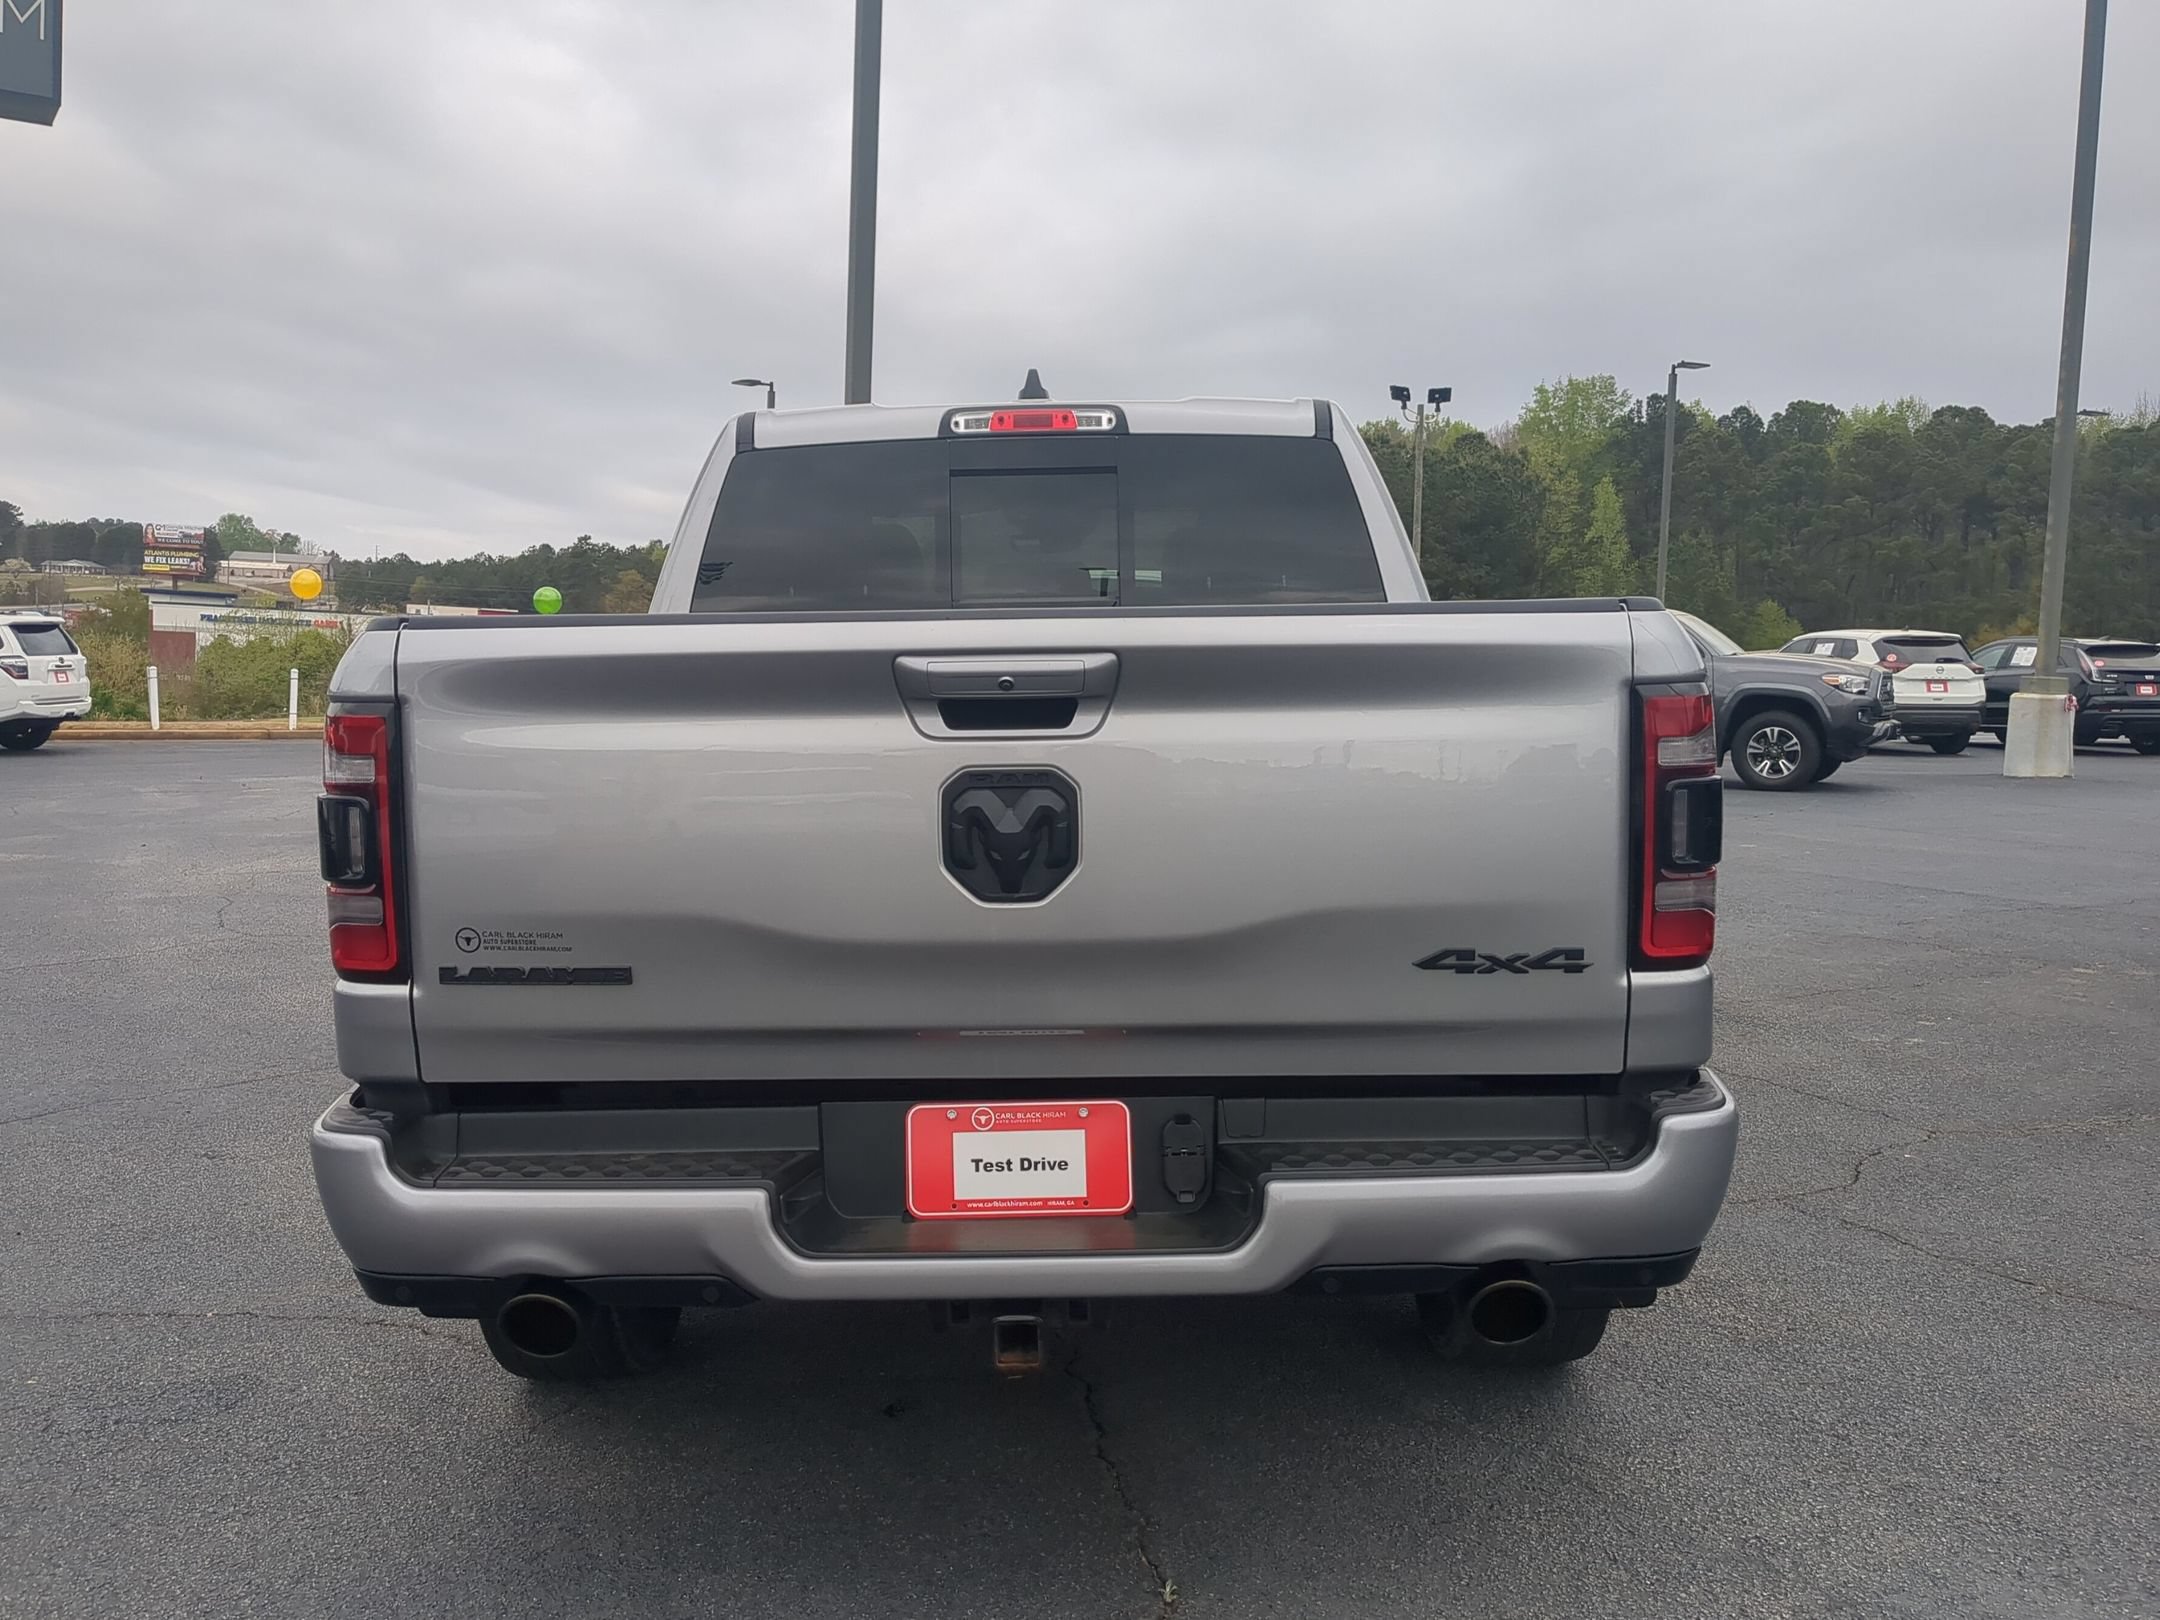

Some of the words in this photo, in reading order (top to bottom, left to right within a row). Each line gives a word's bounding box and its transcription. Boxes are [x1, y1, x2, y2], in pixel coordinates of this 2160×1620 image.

[156, 556, 167, 564] FIX
[168, 557, 191, 565] LEAKS!
[968, 773, 1050, 785] RAM
[482, 930, 504, 938] CARL
[506, 931, 535, 939] BLACK
[536, 932, 564, 940] HIRAM
[483, 945, 573, 953] WWW.CARLBLACKHIRAM.COM
[995, 1112, 1015, 1120] CARL
[1017, 1111, 1041, 1119] BLACK
[1042, 1111, 1067, 1119] HIRAM
[971, 1158, 1013, 1173] Test
[1019, 1157, 1069, 1172] Drive
[967, 1200, 1043, 1208] www.carlblackhiram.com
